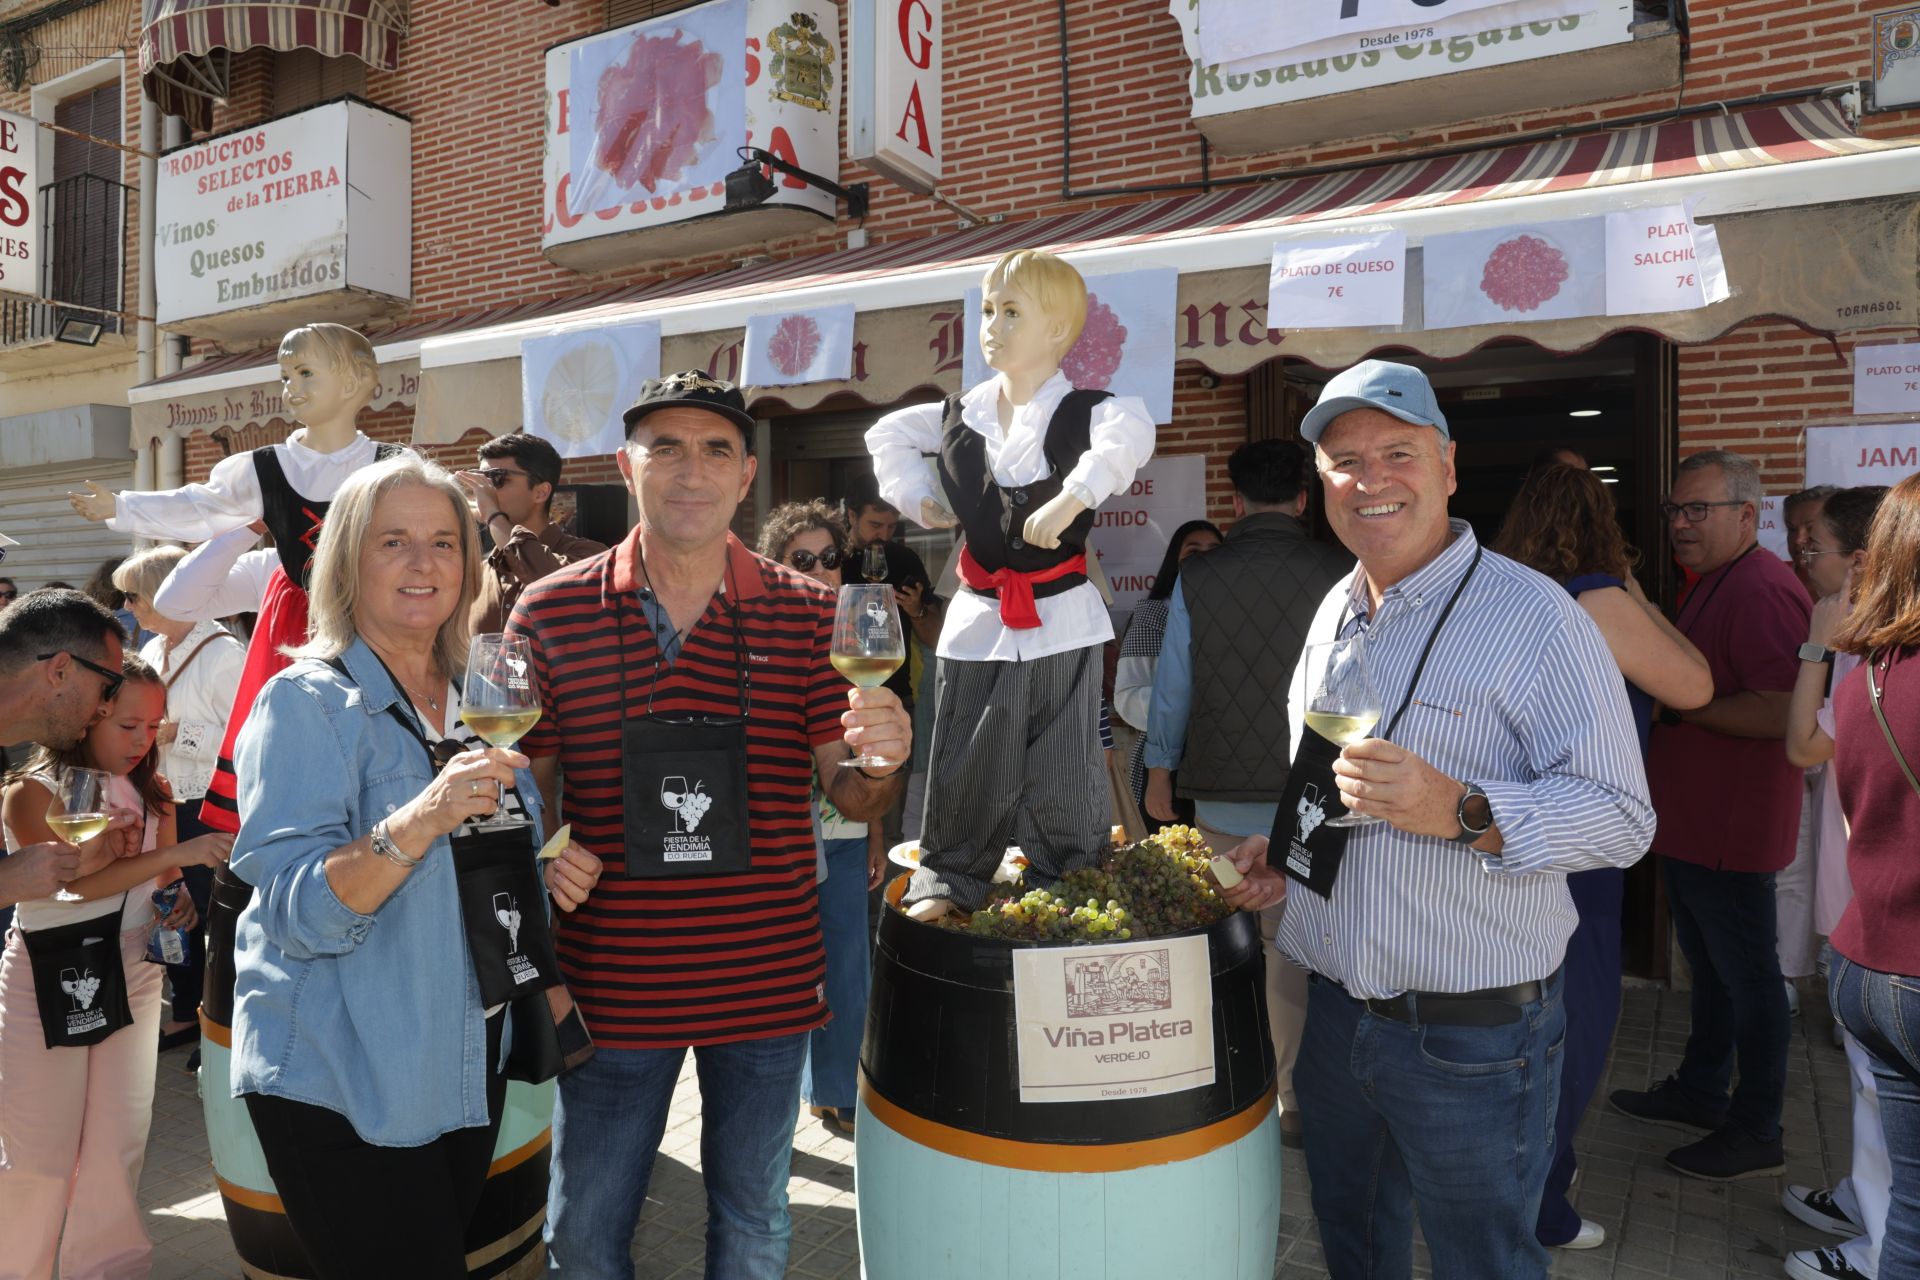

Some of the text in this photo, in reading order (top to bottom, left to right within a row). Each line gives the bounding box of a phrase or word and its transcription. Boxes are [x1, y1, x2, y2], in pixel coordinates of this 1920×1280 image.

[1360, 27, 1434, 48] Desde 1978
[197, 151, 293, 195] SELECTOS
[227, 166, 341, 213] de la TIERRA
[158, 218, 216, 247] Vinos
[190, 240, 265, 278] Quesos
[1280, 259, 1395, 279] PLATO DE QUESO
[216, 260, 341, 303] Embutidos
[1676, 274, 1695, 288] 7€
[1327, 285, 1344, 298] 7€
[1837, 301, 1902, 318] TORNASOL
[1866, 366, 1902, 376] PLATO
[1904, 382, 1918, 391] 7€
[1857, 447, 1918, 468] JAM
[1131, 480, 1154, 496] DE
[664, 843, 710, 851] VENDIMIA
[689, 835, 699, 843] DE
[1043, 1020, 1193, 1048] Viña Platera
[1095, 1050, 1151, 1064] VERDEJO
[1101, 1087, 1148, 1097] Desde 1978
